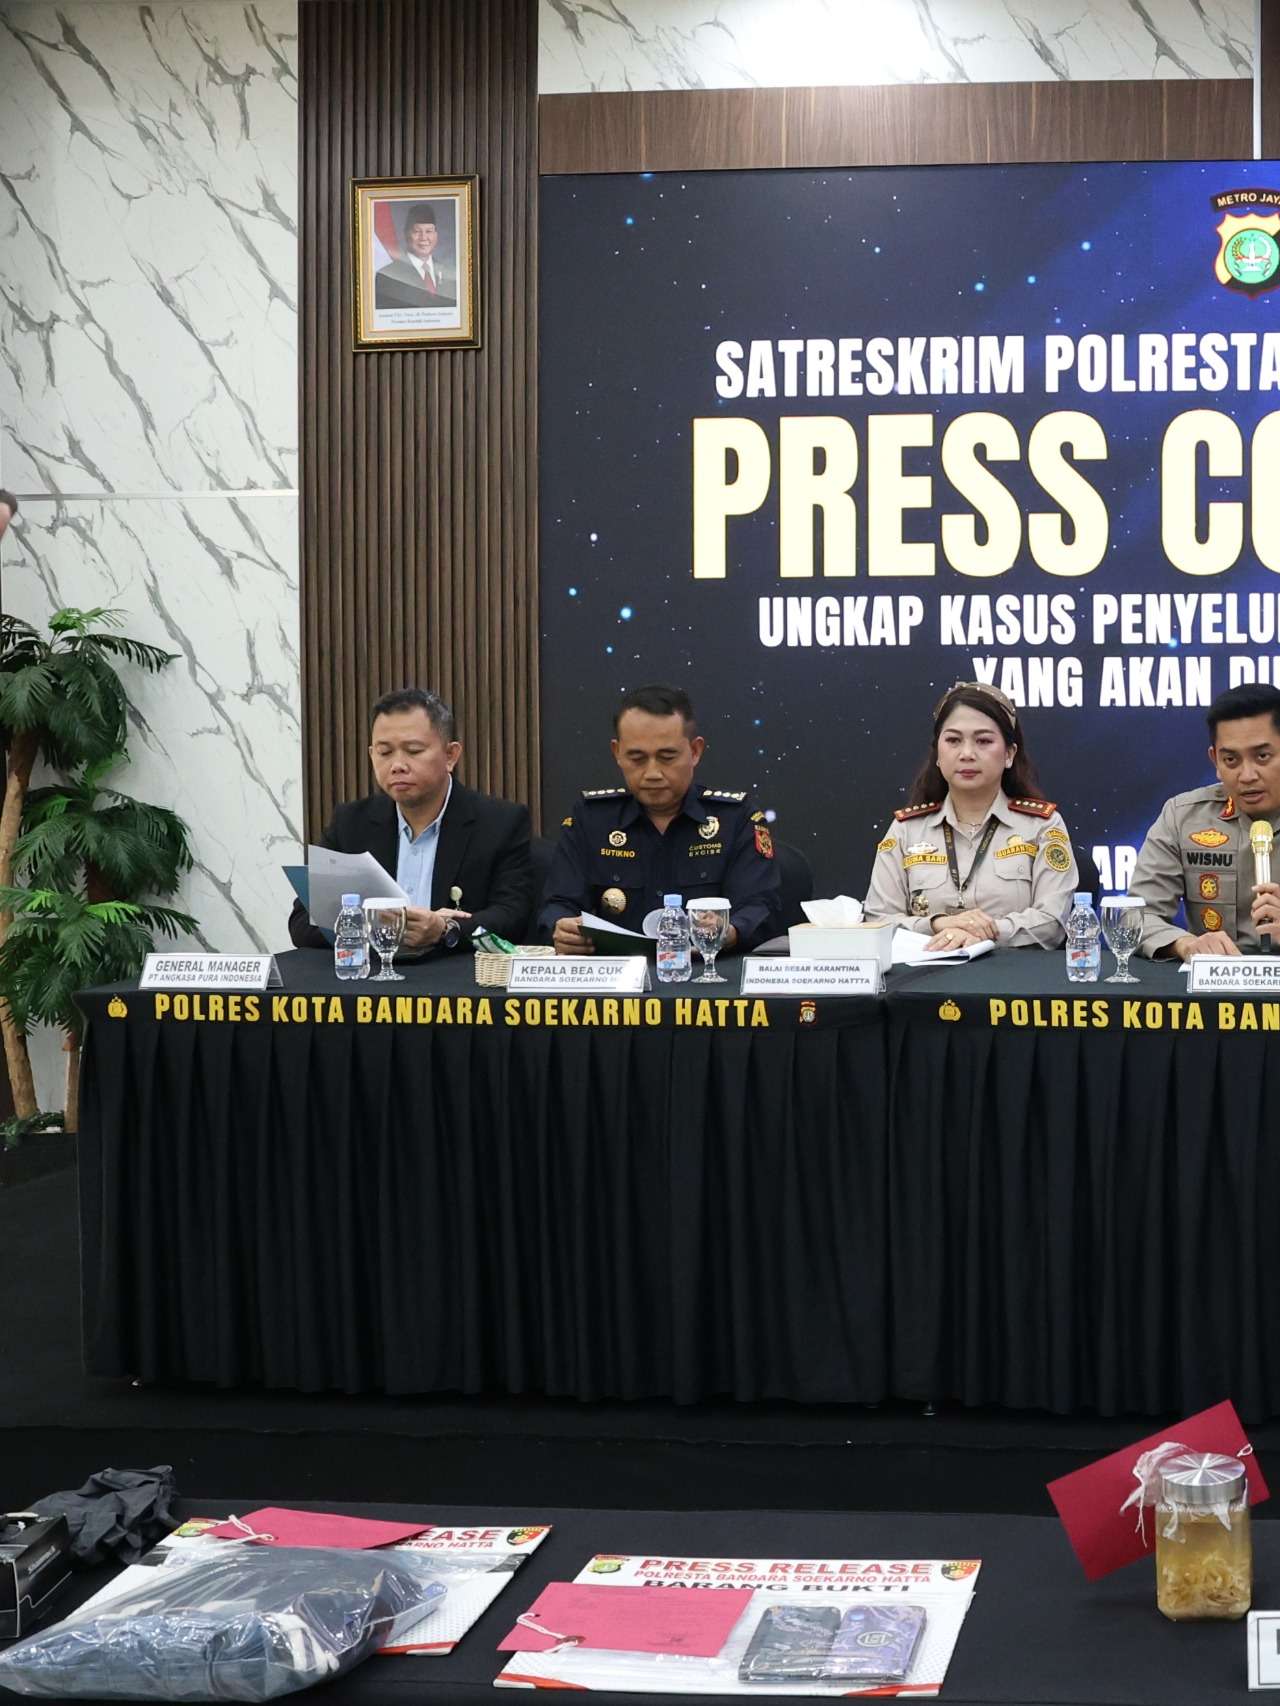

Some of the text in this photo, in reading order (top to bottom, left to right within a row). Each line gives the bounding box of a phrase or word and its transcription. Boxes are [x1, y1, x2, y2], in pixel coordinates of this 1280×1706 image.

[1217, 192, 1257, 207] METRO
[714, 335, 1025, 399] SATRESKRIM
[692, 410, 1109, 579] PRESS
[758, 595, 924, 648] UNGKAP
[939, 593, 1076, 646] KASUS
[972, 656, 1084, 709] YANG
[1100, 655, 1212, 708] AKAN
[600, 848, 636, 859] SUTIKNO
[1186, 851, 1233, 866] WISNU
[155, 960, 261, 973] GENERAL MANAGER
[521, 966, 624, 975] KEPALA BEA CUK
[148, 973, 262, 982] PT ANGKASA PURA INDONESIA
[514, 975, 556, 983] BANDARA
[1199, 978, 1240, 986] BANDARA
[155, 993, 770, 1027] POLRES KOTA BANDARA SOEKARNO HATTA
[990, 999, 1109, 1028] POLRES
[1123, 1001, 1204, 1030] KOTA
[417, 1529, 502, 1541] EASE
[639, 1559, 935, 1575] PRESS RELEASE
[633, 1570, 931, 1583] POLRESTA BANDARA SOEKARNO HATTA
[642, 1580, 911, 1592] BARANG BUKTI
